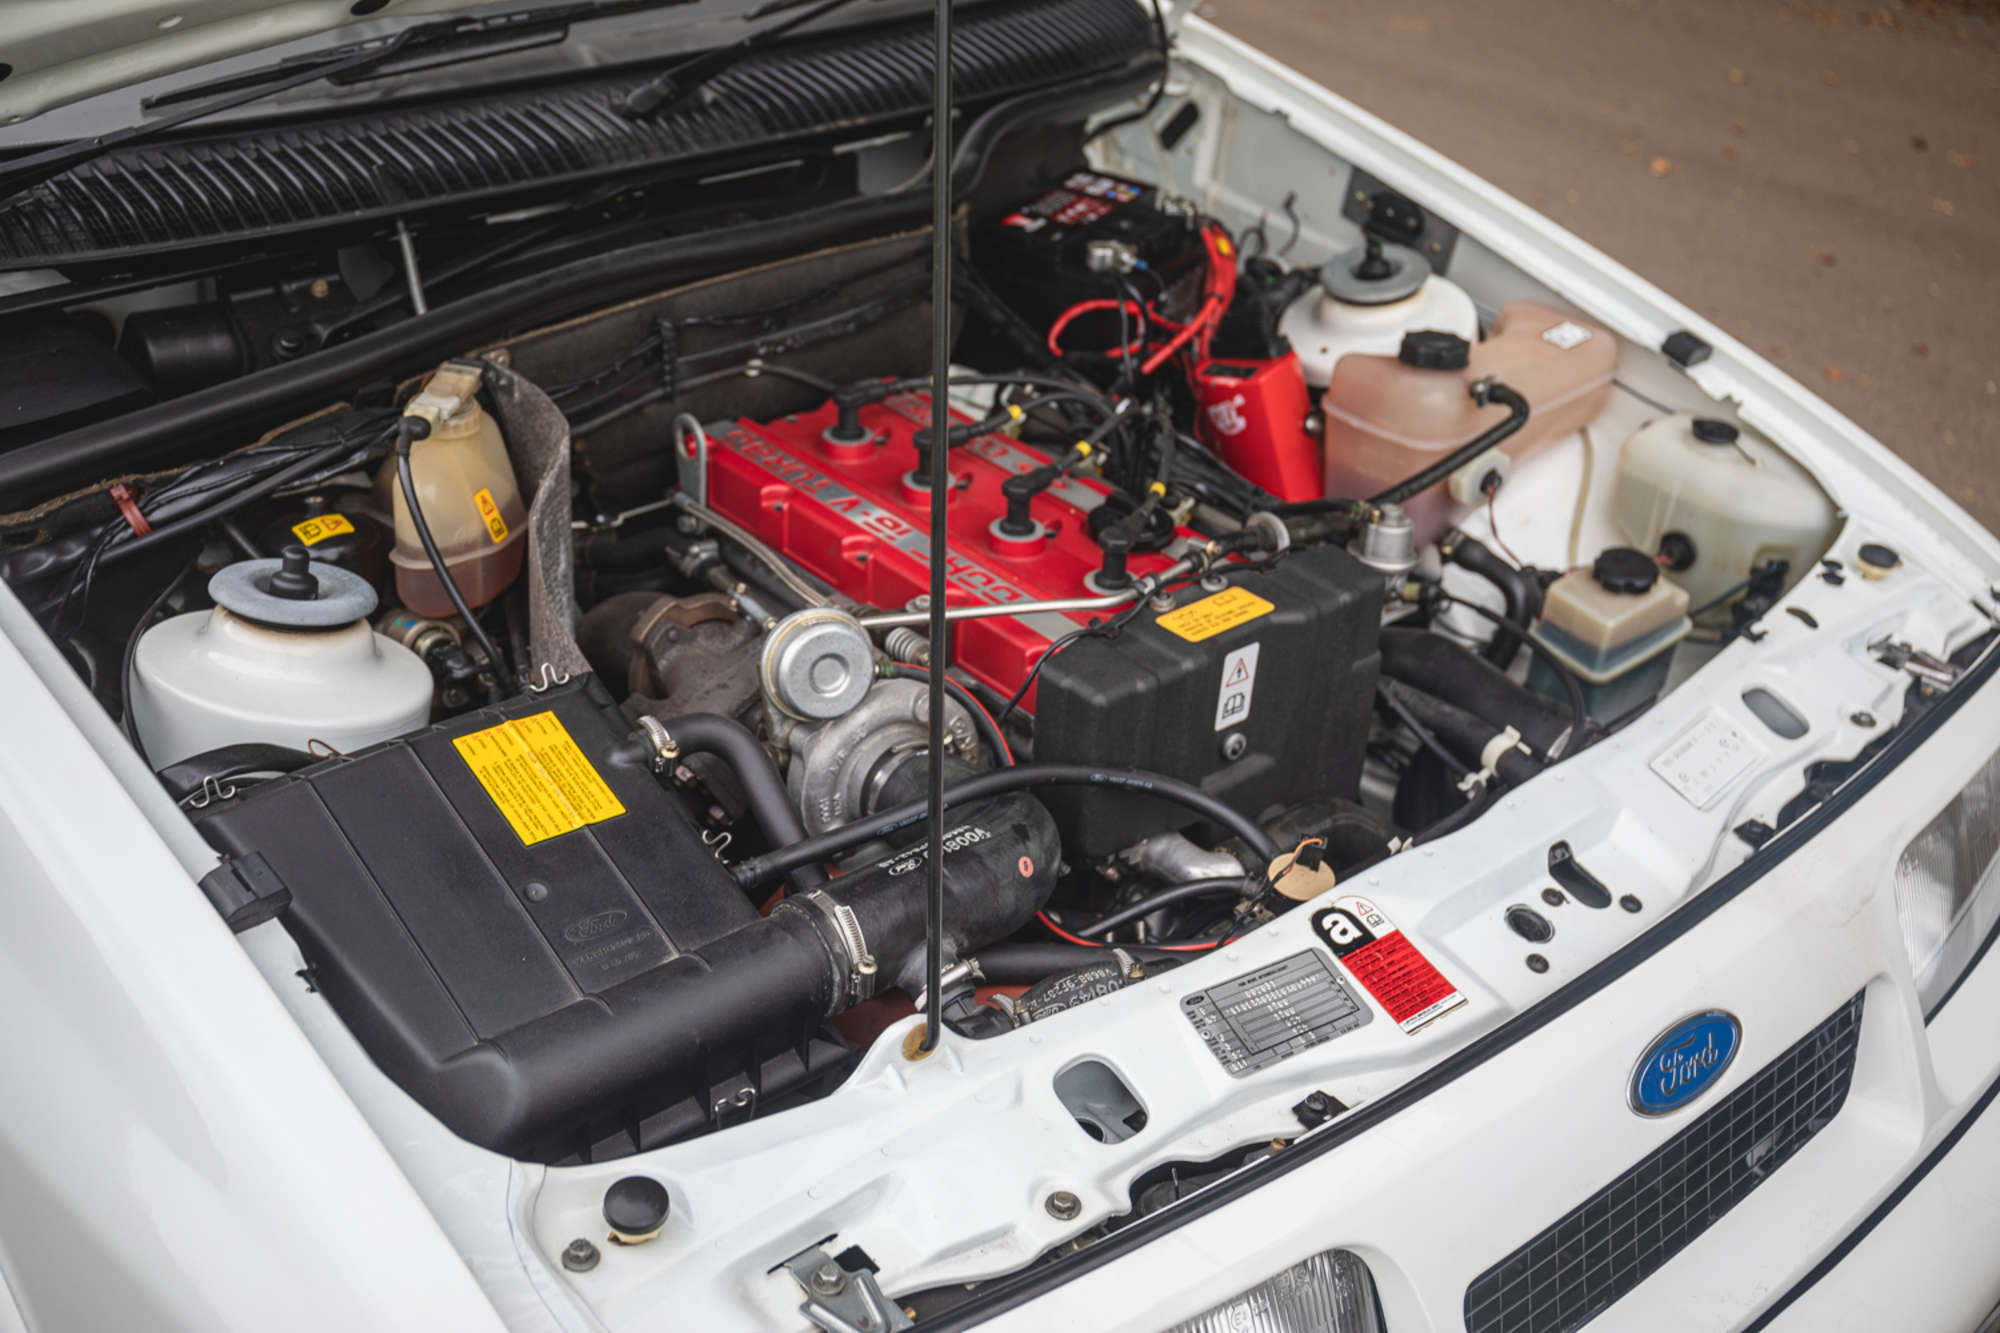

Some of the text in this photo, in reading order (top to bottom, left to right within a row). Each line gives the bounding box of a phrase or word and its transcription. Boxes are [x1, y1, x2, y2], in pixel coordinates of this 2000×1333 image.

[721, 427, 830, 496] TURBO
[829, 496, 913, 543] 16-V
[1321, 913, 1363, 944] a
[1659, 1032, 1719, 1096] Ford
